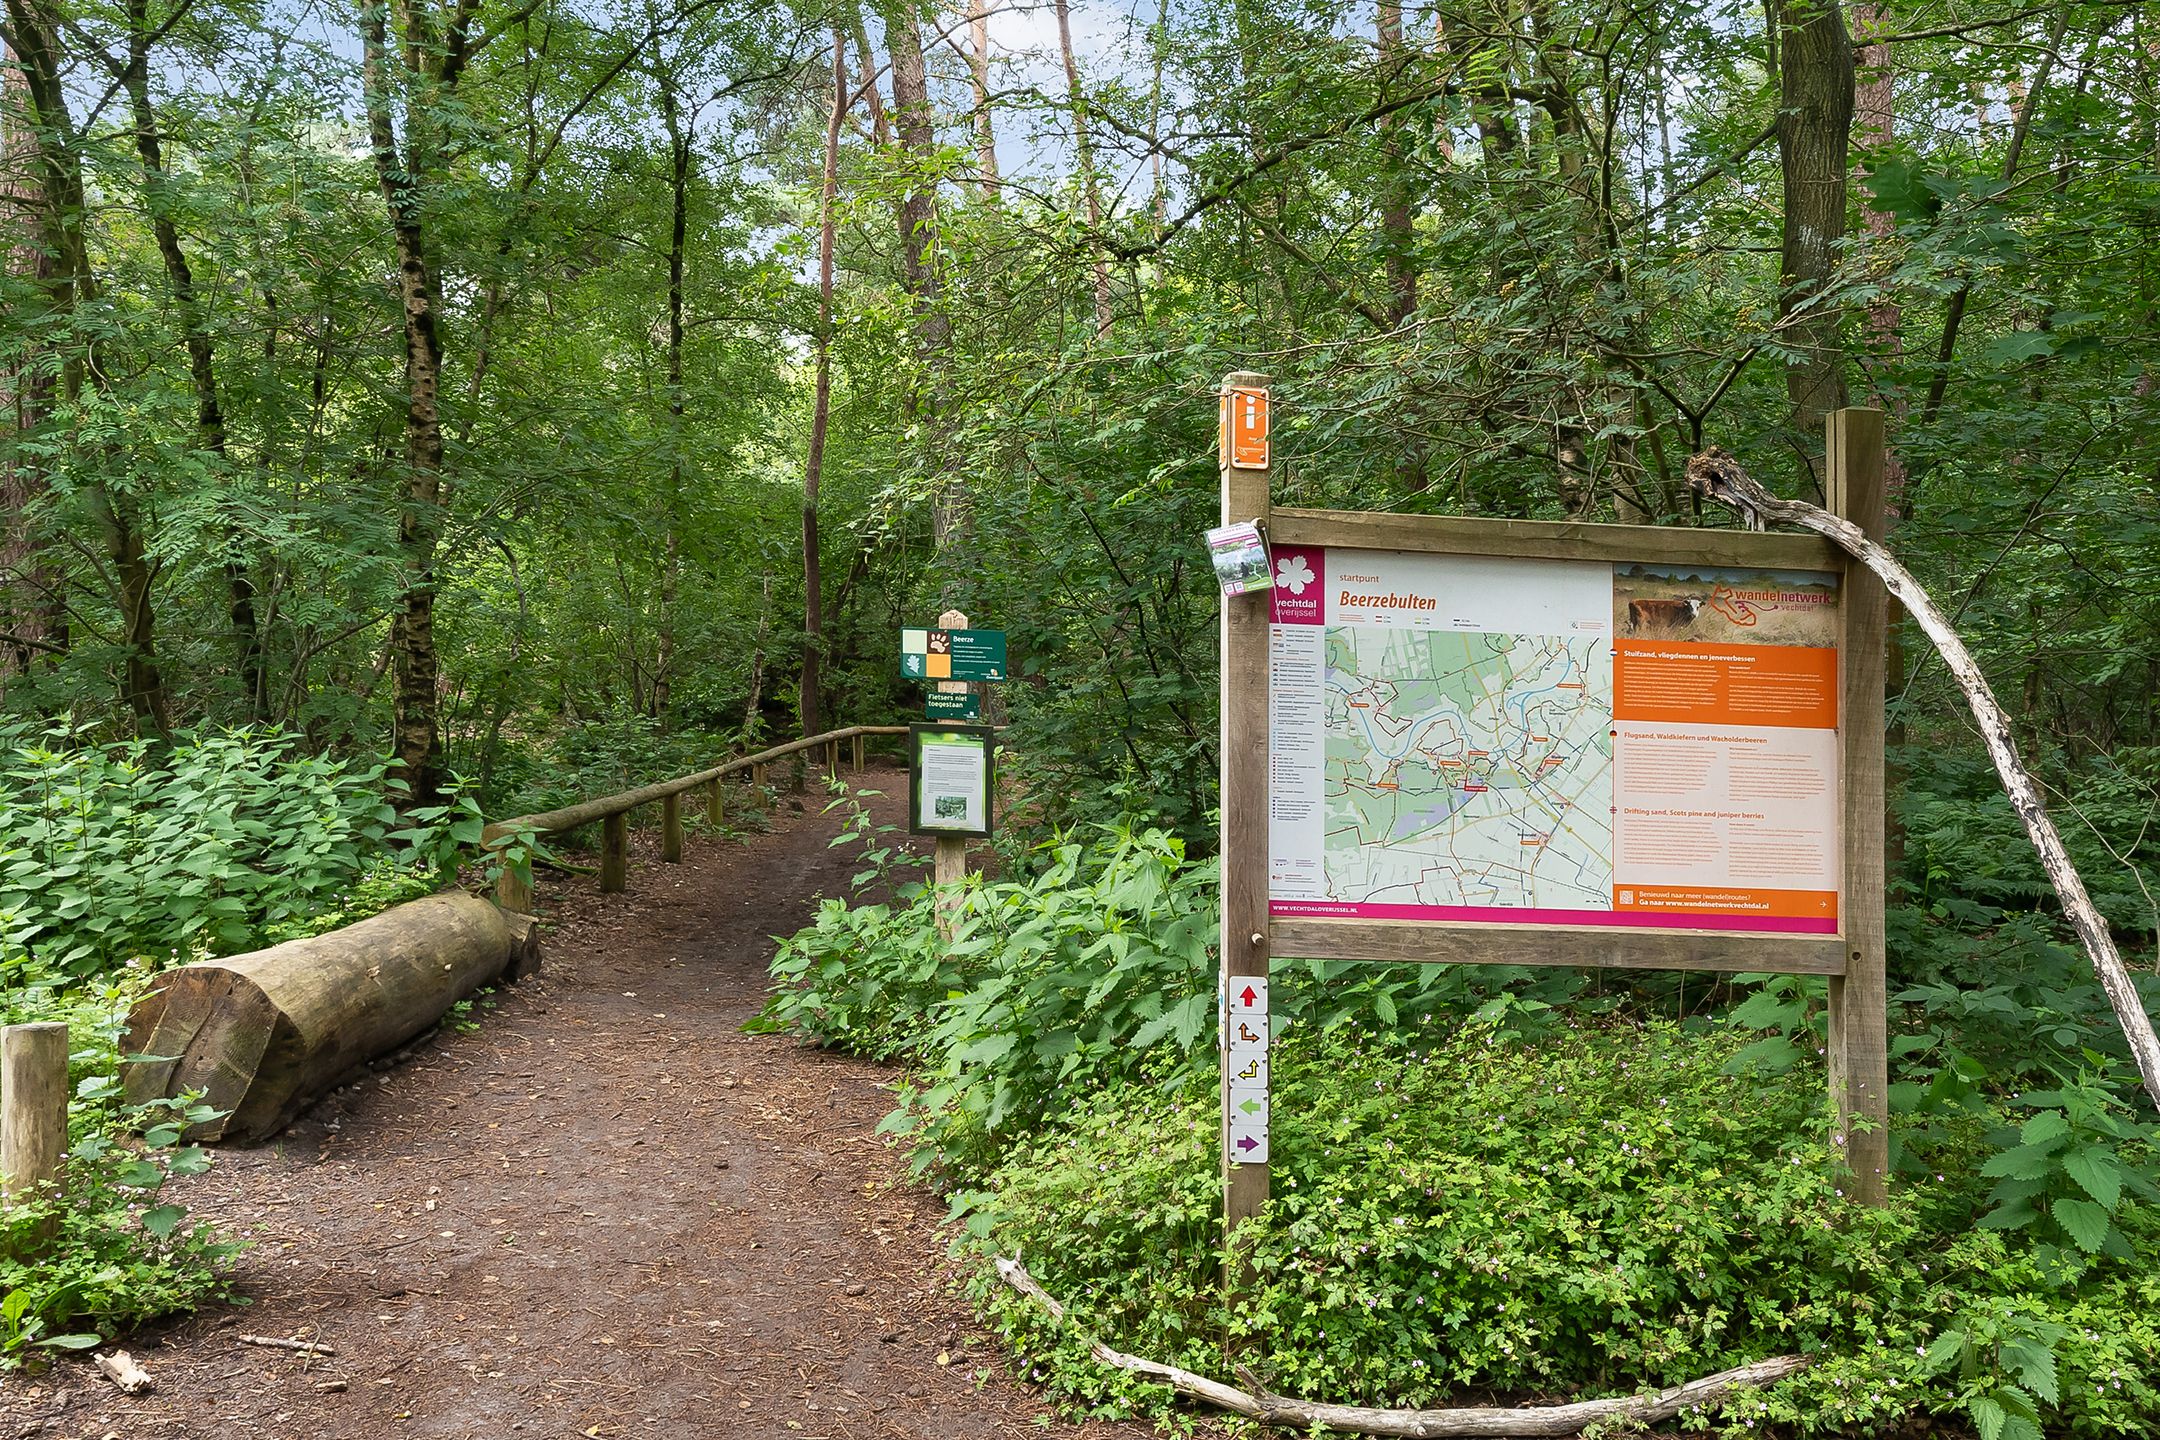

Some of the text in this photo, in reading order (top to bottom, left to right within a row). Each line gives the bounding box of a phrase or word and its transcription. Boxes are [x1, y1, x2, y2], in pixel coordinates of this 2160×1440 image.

[1339, 574, 1380, 584] startpunt
[1340, 591, 1437, 610] Beerzebulten
[1735, 590, 1831, 604] wandelnetwerk
[1276, 599, 1317, 608] vechtdal
[1780, 603, 1815, 612] vechtdal
[1275, 609, 1317, 618] overijssel
[953, 635, 975, 643] Beerze
[1623, 650, 1657, 659] Stuifzand,
[1658, 651, 1699, 660] vliegdennen
[1709, 654, 1756, 662] jeneverbessen
[928, 693, 954, 701] Fietsers
[1624, 731, 1656, 740] Flugsand,
[1657, 733, 1696, 741] Waldkiefern
[1711, 736, 1768, 744] Wacholderbeeren
[1624, 808, 1650, 816] Drifting
[1666, 900, 1770, 909] www.wandelnetwerkvechtdal.nl
[1272, 905, 1359, 914] WWW.VECHTDALOVERIJSSEL.NL
